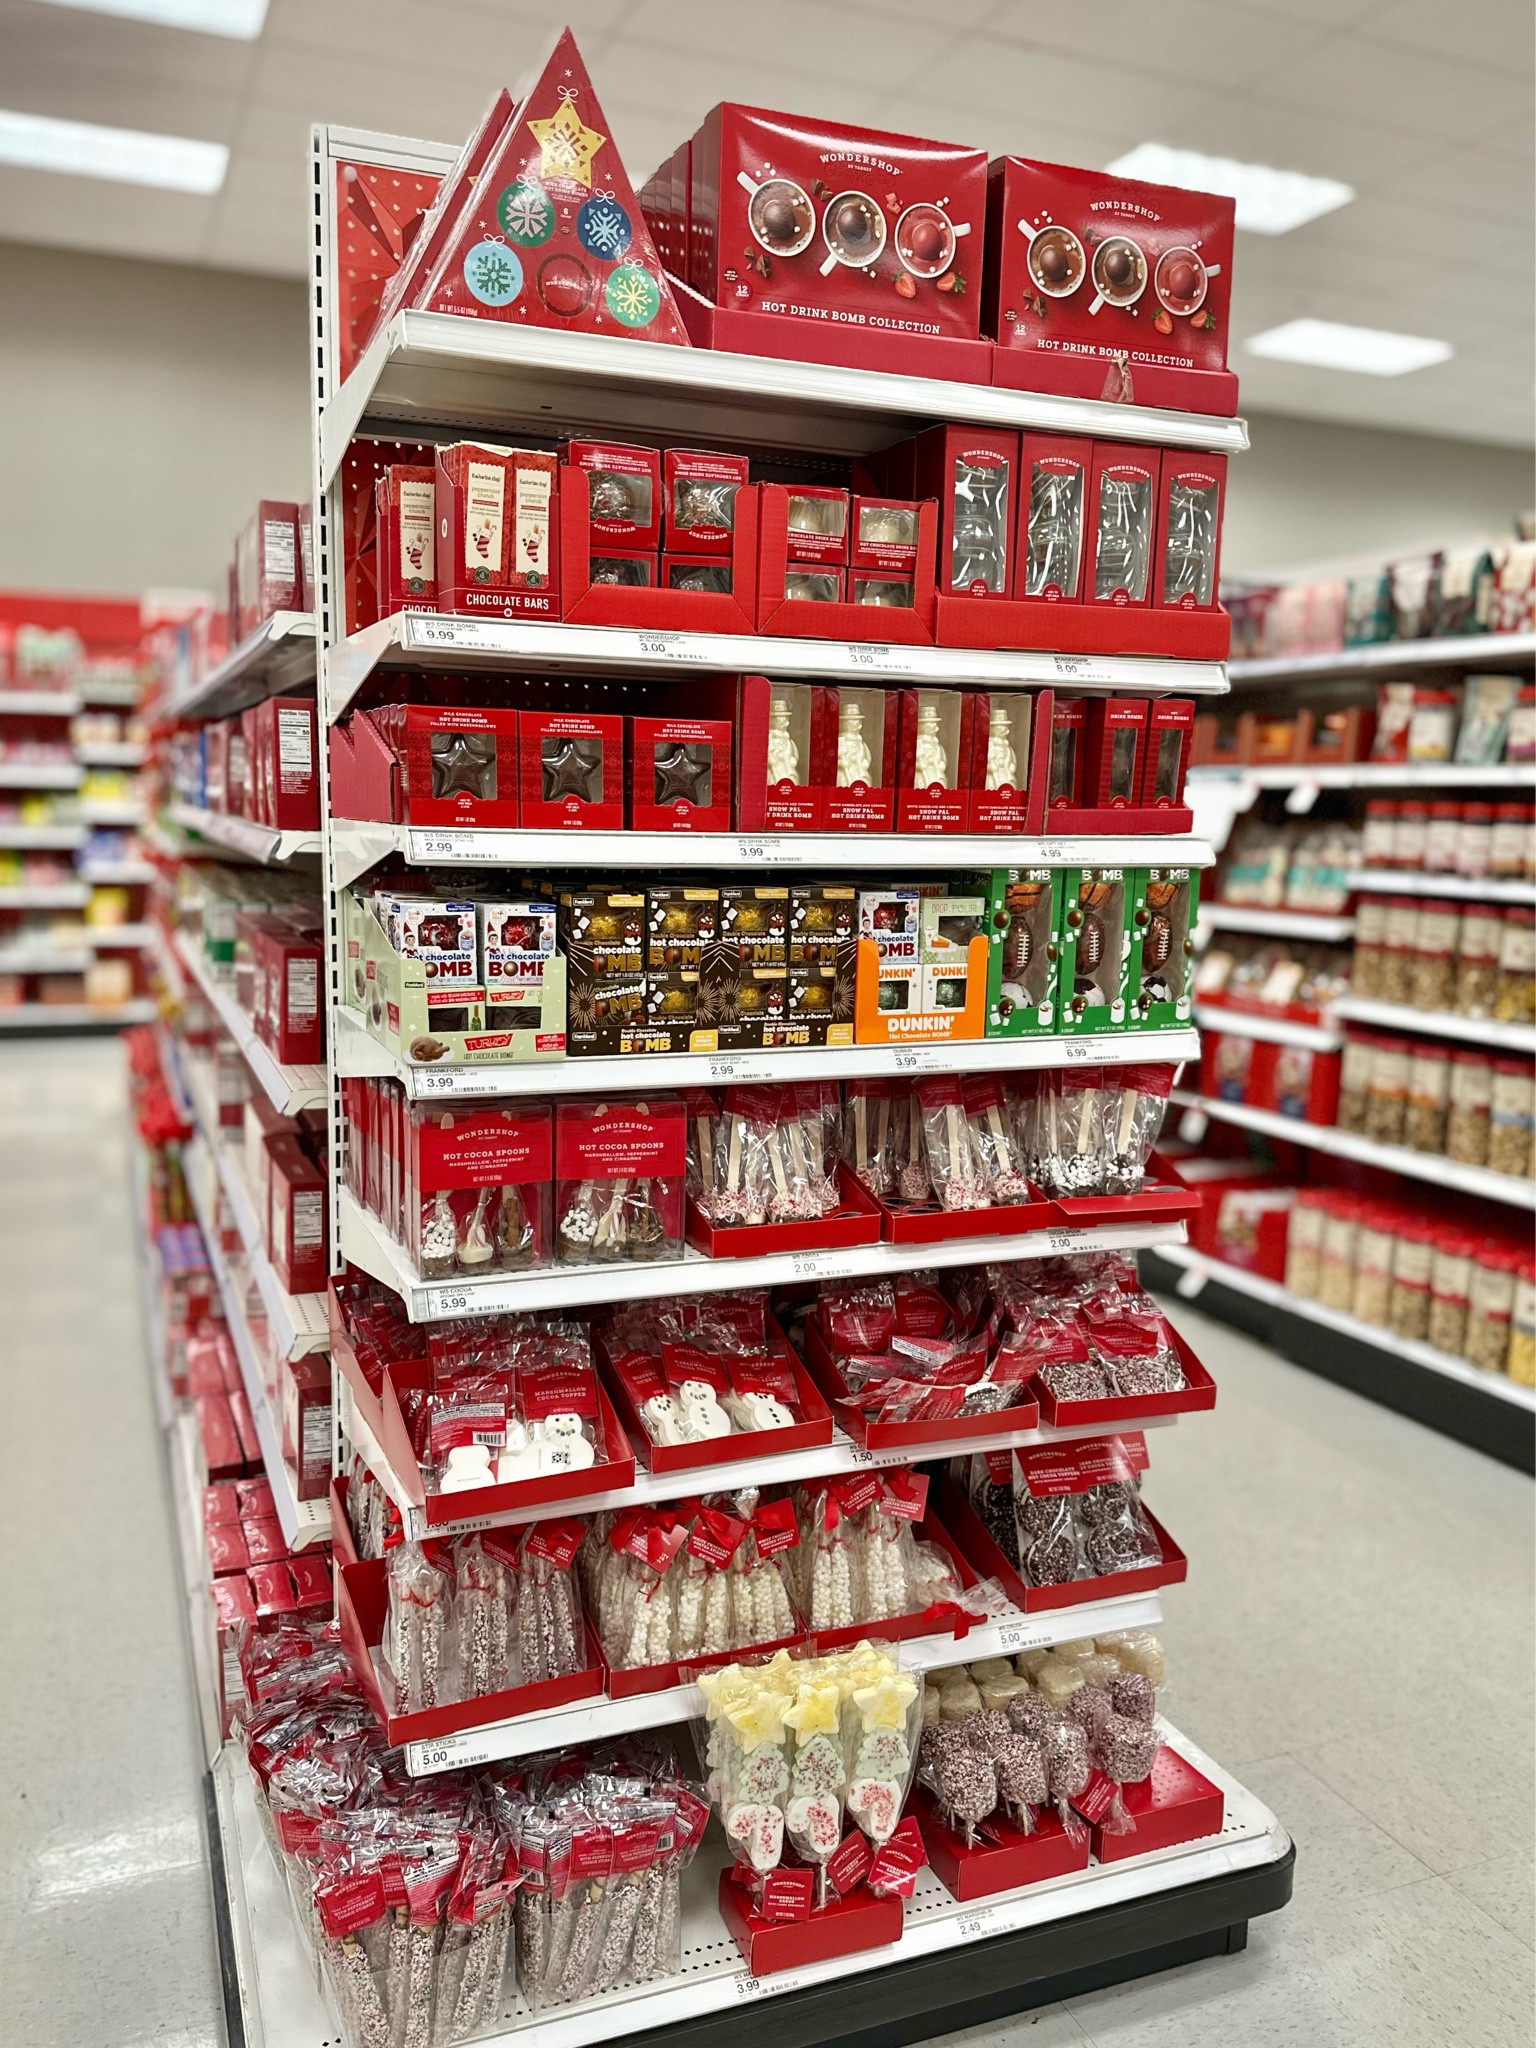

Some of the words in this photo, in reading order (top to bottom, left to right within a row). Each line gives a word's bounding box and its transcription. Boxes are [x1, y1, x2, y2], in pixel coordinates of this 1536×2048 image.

[820, 153, 900, 176] WONDERSHOP
[1090, 201, 1160, 221] WONDERSHOP
[737, 285, 748, 294] 12
[762, 301, 787, 313] HOT
[790, 305, 829, 319] DRINK
[832, 310, 866, 325] BOMB
[869, 316, 941, 335] COLLECTION
[1016, 324, 1025, 333] 12
[1037, 339, 1060, 350] HOT
[1062, 342, 1096, 355] DRINK
[1099, 347, 1129, 359] BOMB
[1132, 351, 1193, 367] COLLECTION
[962, 450, 1005, 461] WONDERSHOP
[1039, 457, 1080, 468] WONDERSHOP
[1108, 465, 1149, 477] WONDERSHOP
[1177, 472, 1216, 483] WONDERSHOP
[472, 486, 500, 495] peppermint
[466, 594, 521, 607] CHOCOLATE
[524, 597, 549, 610] BARS
[427, 630, 454, 640] 9.99
[640, 642, 666, 652] 3.00
[850, 654, 873, 663] 3.00
[1056, 664, 1077, 673] 8.00
[425, 842, 452, 852] 2.99
[740, 847, 763, 857] 3.99
[1041, 849, 1061, 858] 4.99
[932, 903, 948, 913] DROP
[952, 902, 977, 912] POUR
[650, 938, 667, 946] hot
[740, 936, 785, 944] chocolate
[593, 946, 641, 954] chocolate
[425, 952, 471, 961] chocolate
[489, 952, 504, 960] hot
[506, 953, 550, 961] chocolate
[932, 967, 967, 976] DUNKI
[491, 991, 524, 1002] TURKEY
[595, 984, 640, 1000] chocolate
[888, 1015, 954, 1032] DUNKIN'
[637, 1031, 670, 1039] chocolate
[466, 1035, 511, 1050] TURKEY
[1067, 1048, 1086, 1057] 6.99
[895, 1056, 917, 1066] 3.99
[710, 1065, 733, 1075] 2.99
[427, 1077, 453, 1088] 3.99
[592, 1122, 654, 1134] WONDERSHOP
[456, 1128, 519, 1142] WONDERSHOP
[464, 1151, 493, 1159] COCOA
[496, 1147, 530, 1156] SPOONS
[449, 1159, 491, 1167] MARSHMALLOW,
[1050, 1238, 1070, 1248] 2.00
[794, 1263, 816, 1273] 2.00
[441, 1297, 466, 1309] 5.99
[537, 1372, 581, 1381] WONDERSHOP
[534, 1387, 586, 1397] MARSHMALLOW
[852, 1451, 873, 1462] 1.50
[693, 1540, 709, 1550] COATED
[693, 1536, 707, 1545] WHITE
[707, 1542, 730, 1555] CHOCOLATE
[1000, 1632, 1020, 1644] 5.00
[423, 1751, 447, 1765] 5.00
[960, 1922, 981, 1935] 2.49
[737, 1979, 760, 1994] 3.99
